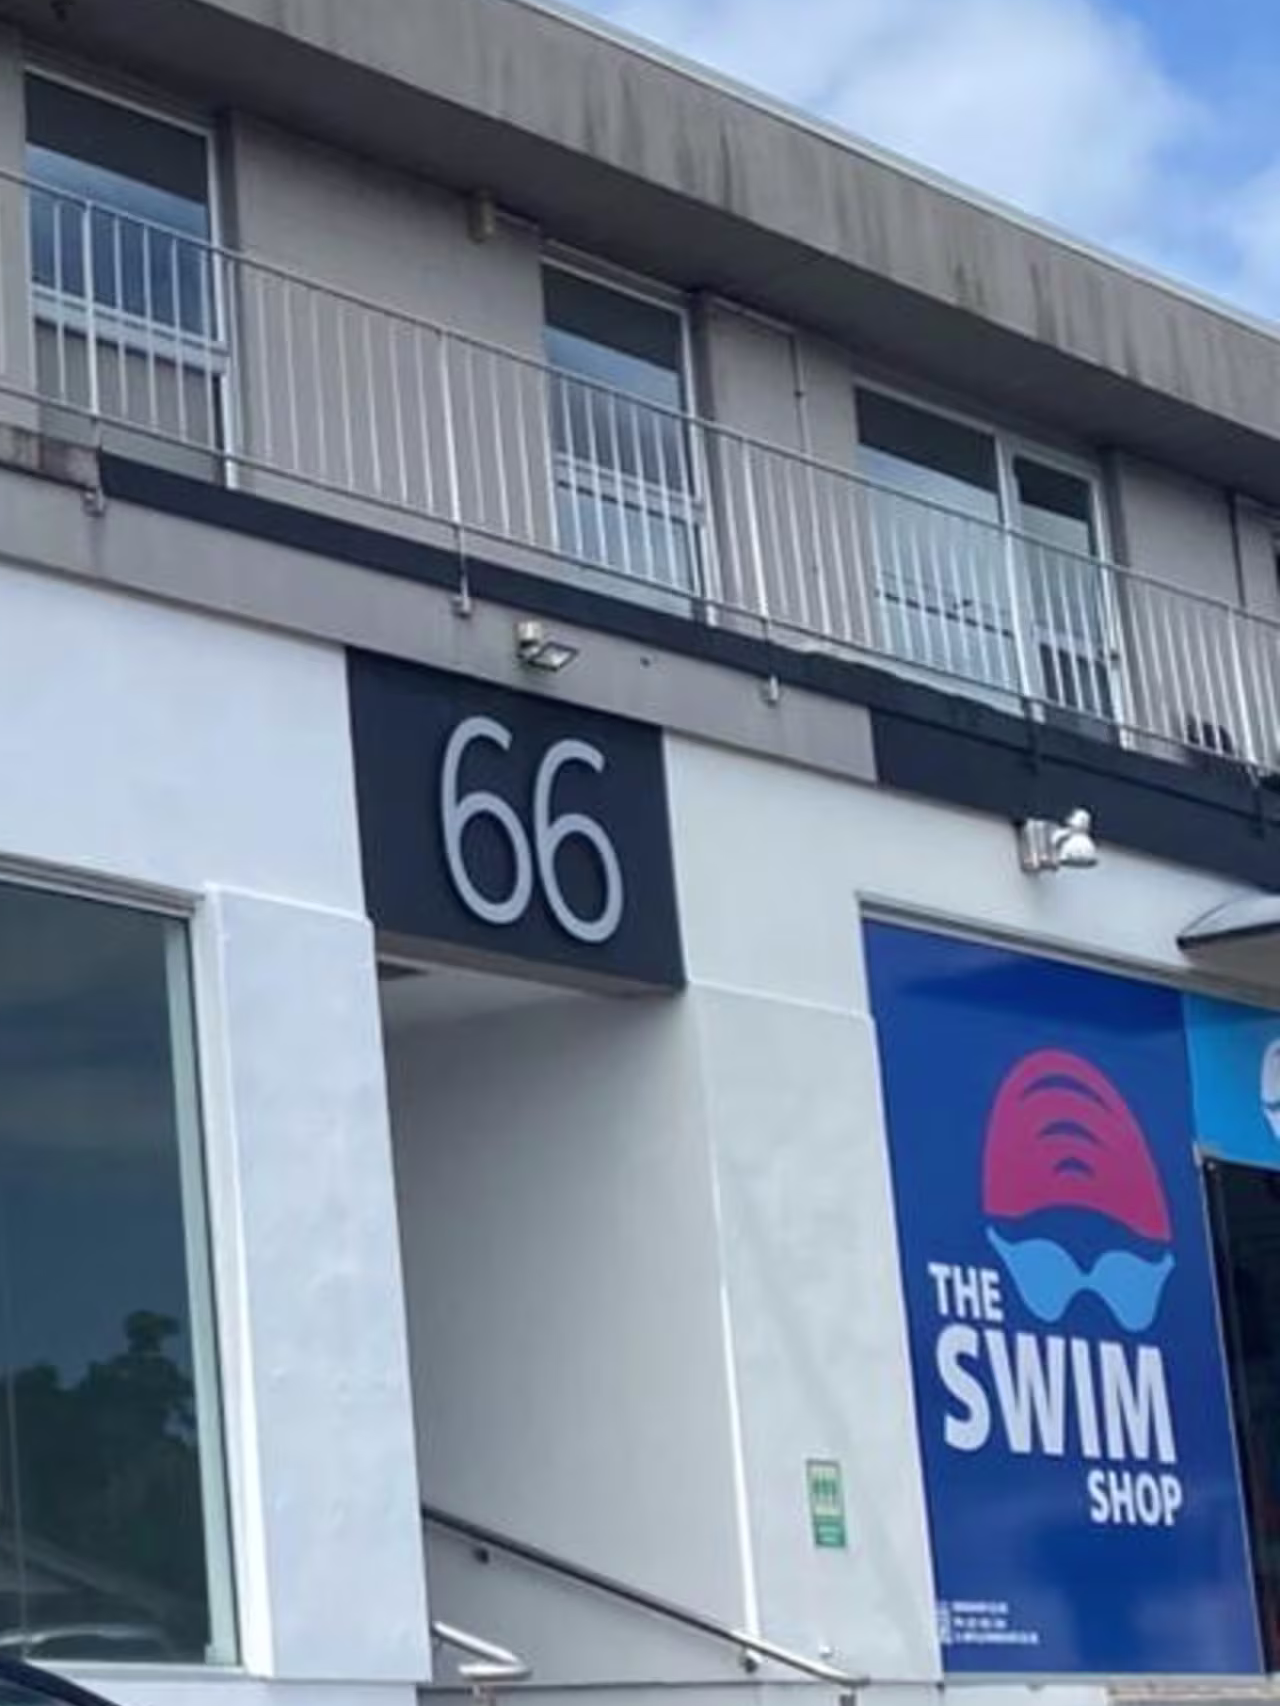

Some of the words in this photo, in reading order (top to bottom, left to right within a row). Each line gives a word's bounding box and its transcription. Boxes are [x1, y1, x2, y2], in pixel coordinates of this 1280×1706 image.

[441, 714, 624, 943] 66
[927, 1261, 1004, 1322] THE
[936, 1323, 1177, 1465] SWIM
[1086, 1468, 1183, 1527] SHOP
